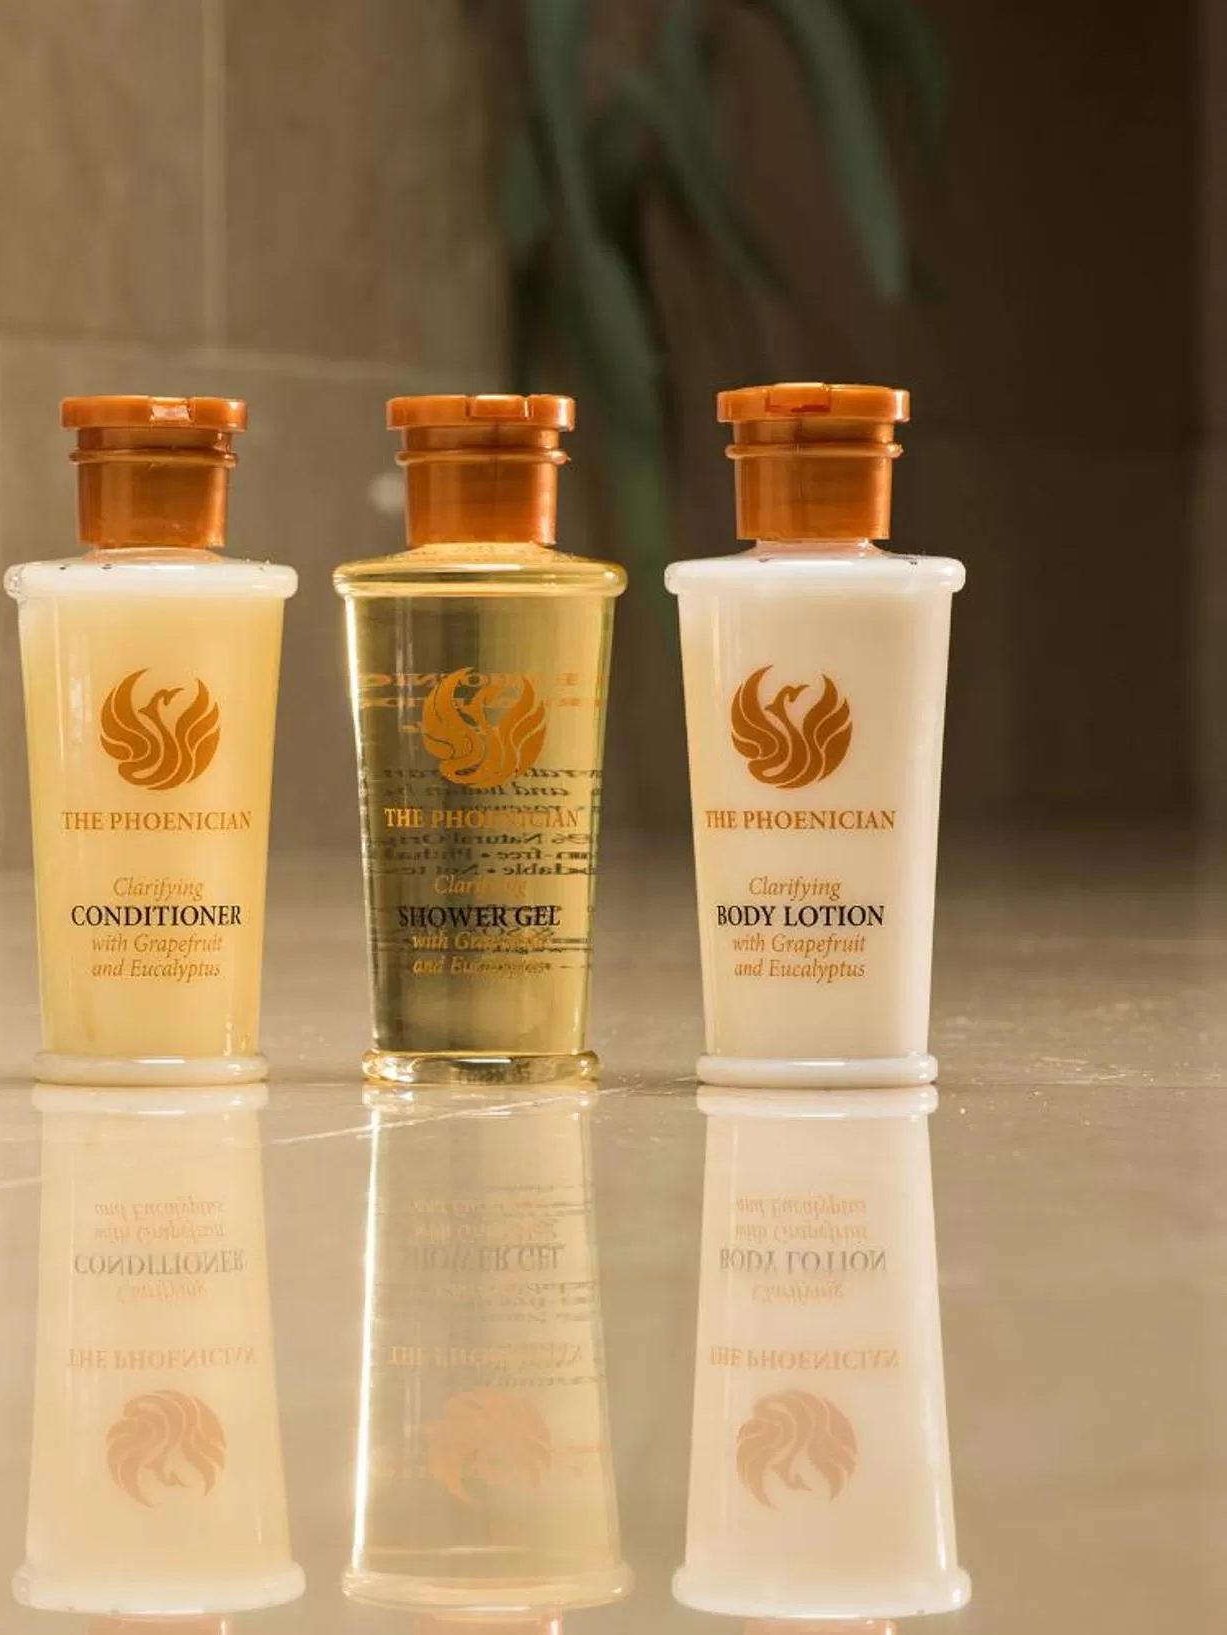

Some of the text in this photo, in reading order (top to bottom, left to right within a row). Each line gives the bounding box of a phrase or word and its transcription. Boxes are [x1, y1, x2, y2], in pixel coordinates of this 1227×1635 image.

[62, 811, 252, 831] THE PHOENICIAN
[383, 807, 423, 828] THE
[704, 810, 896, 830] THE PHOENICIAN
[113, 876, 205, 901] Clarifying
[748, 875, 842, 902] Clarifying
[71, 905, 242, 926] CONDITIONER
[399, 905, 561, 927] SHOWER GEL
[717, 905, 885, 927] BODY LOTION
[92, 933, 223, 958] with Grapefruit
[732, 932, 866, 959] with Grapefruit
[91, 959, 221, 984] and Eucalyptus
[734, 957, 865, 984] and Eucalyptus
